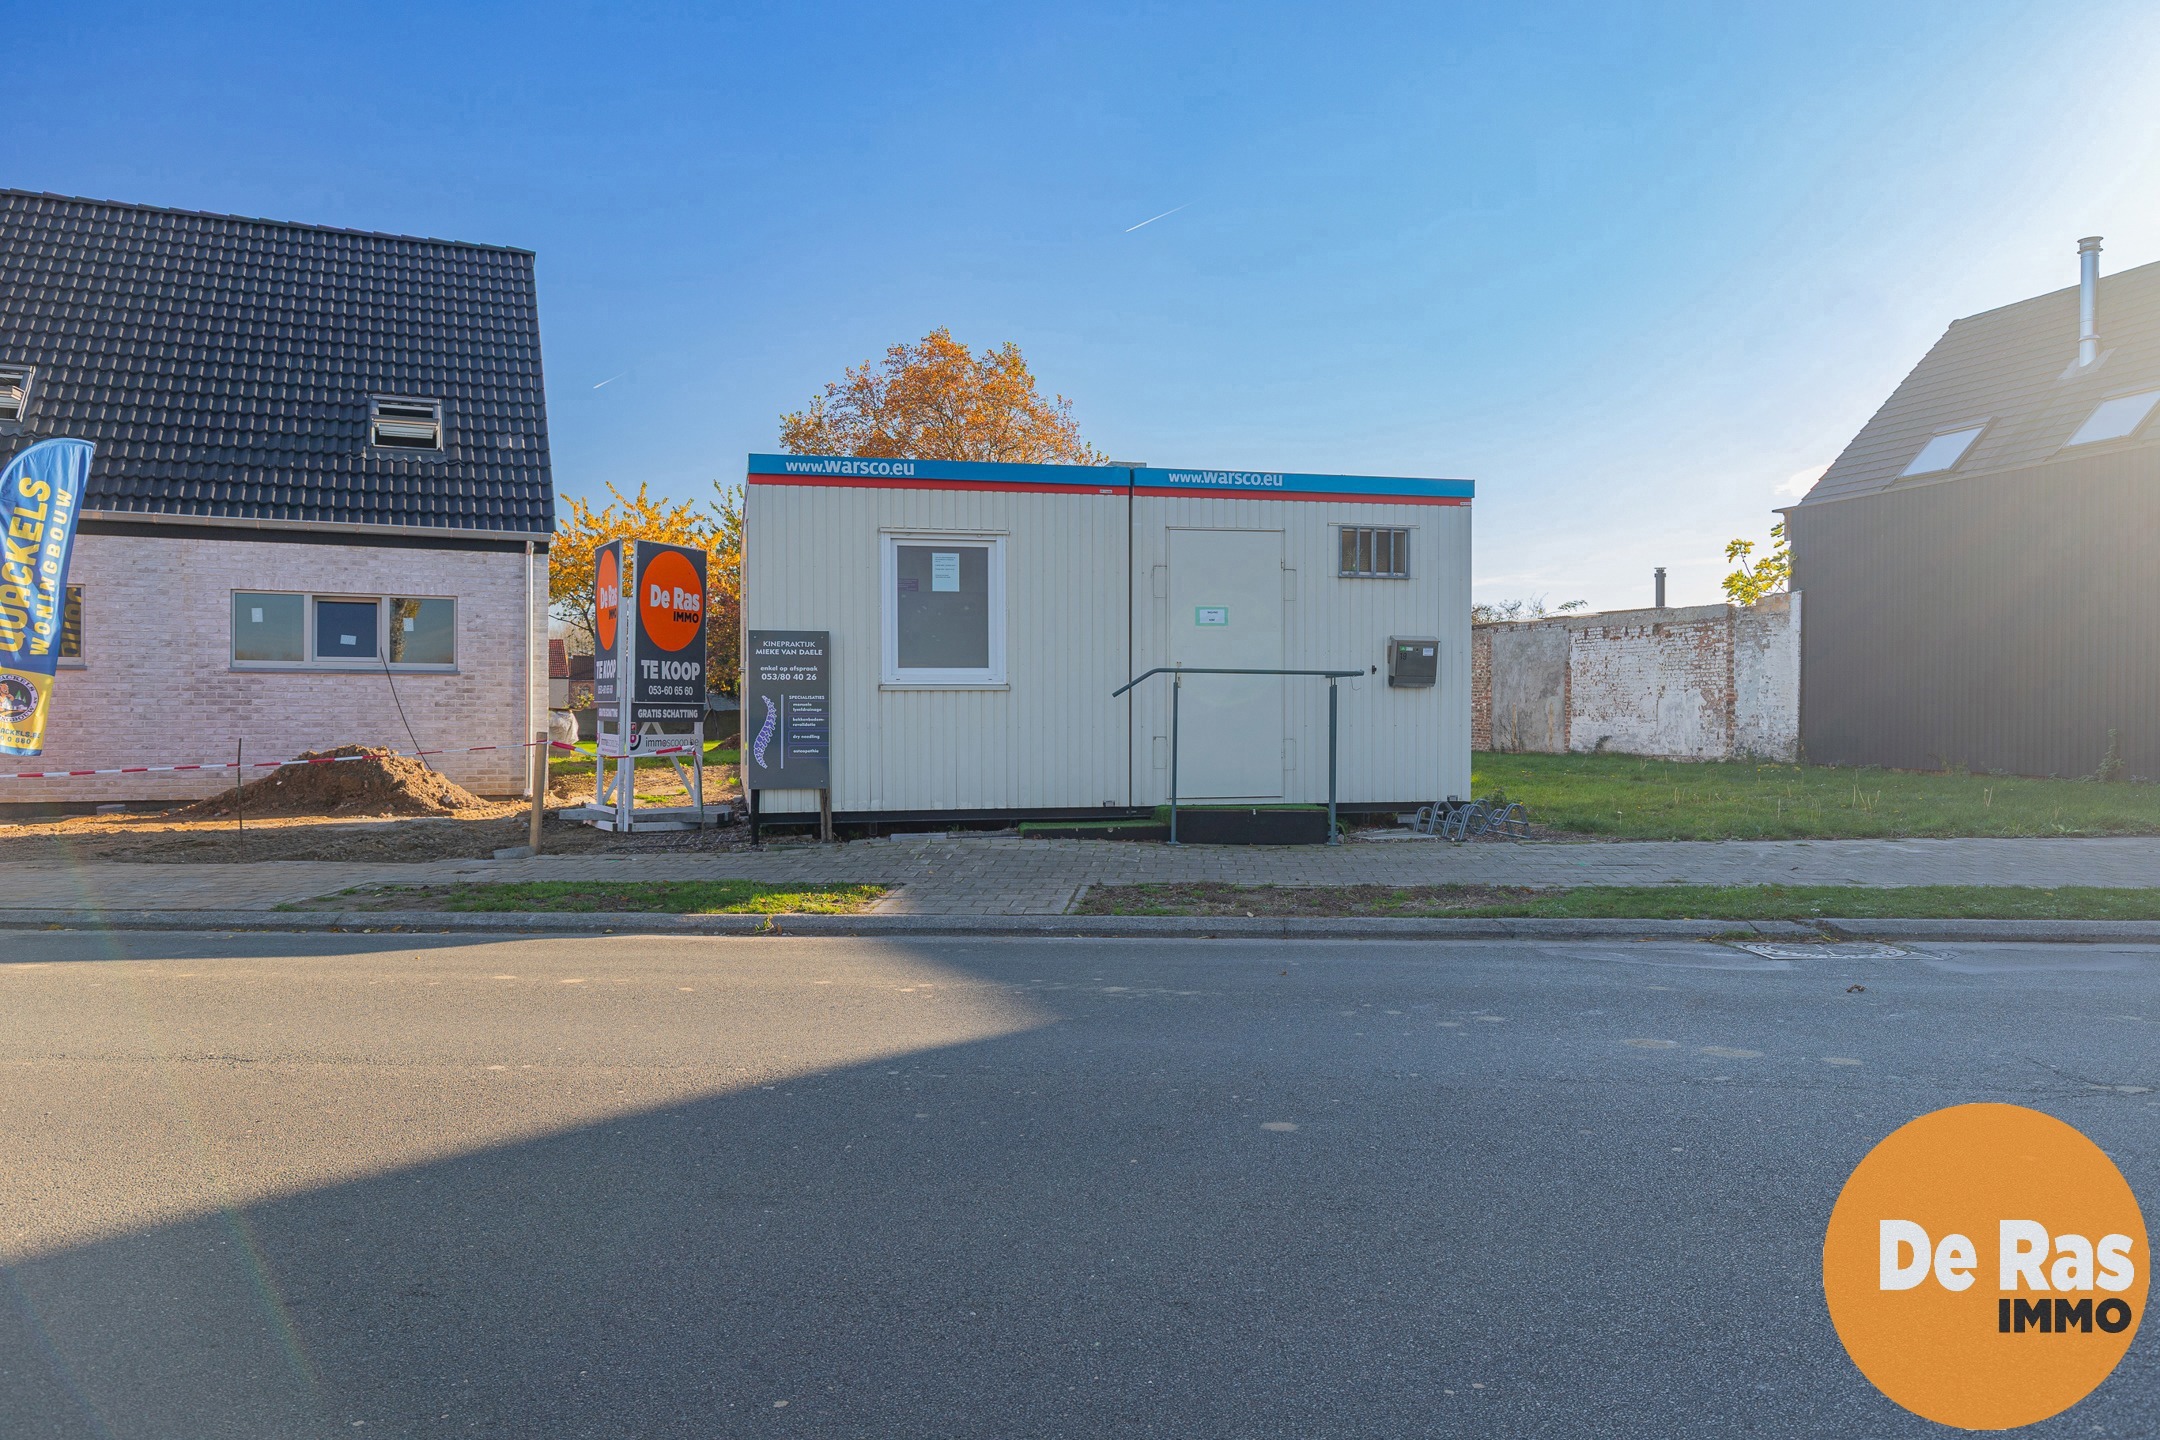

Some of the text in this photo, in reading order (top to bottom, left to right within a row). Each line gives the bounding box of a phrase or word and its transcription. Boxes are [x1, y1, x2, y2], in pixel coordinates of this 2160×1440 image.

[786, 460, 915, 476] www.Warsco.eu
[1168, 471, 1283, 487] www.Warsco.eu
[29, 488, 73, 655] WONINGBOUW
[650, 584, 700, 611] De Ras
[673, 611, 699, 624] IMMO
[596, 661, 603, 680] TE
[641, 660, 701, 681] TE KOOP
[761, 673, 817, 681] 053/80 40 26
[789, 665, 818, 673] afspraak
[648, 685, 694, 696] 053-60 65 60
[638, 709, 698, 719] GRATIS SCHATTING
